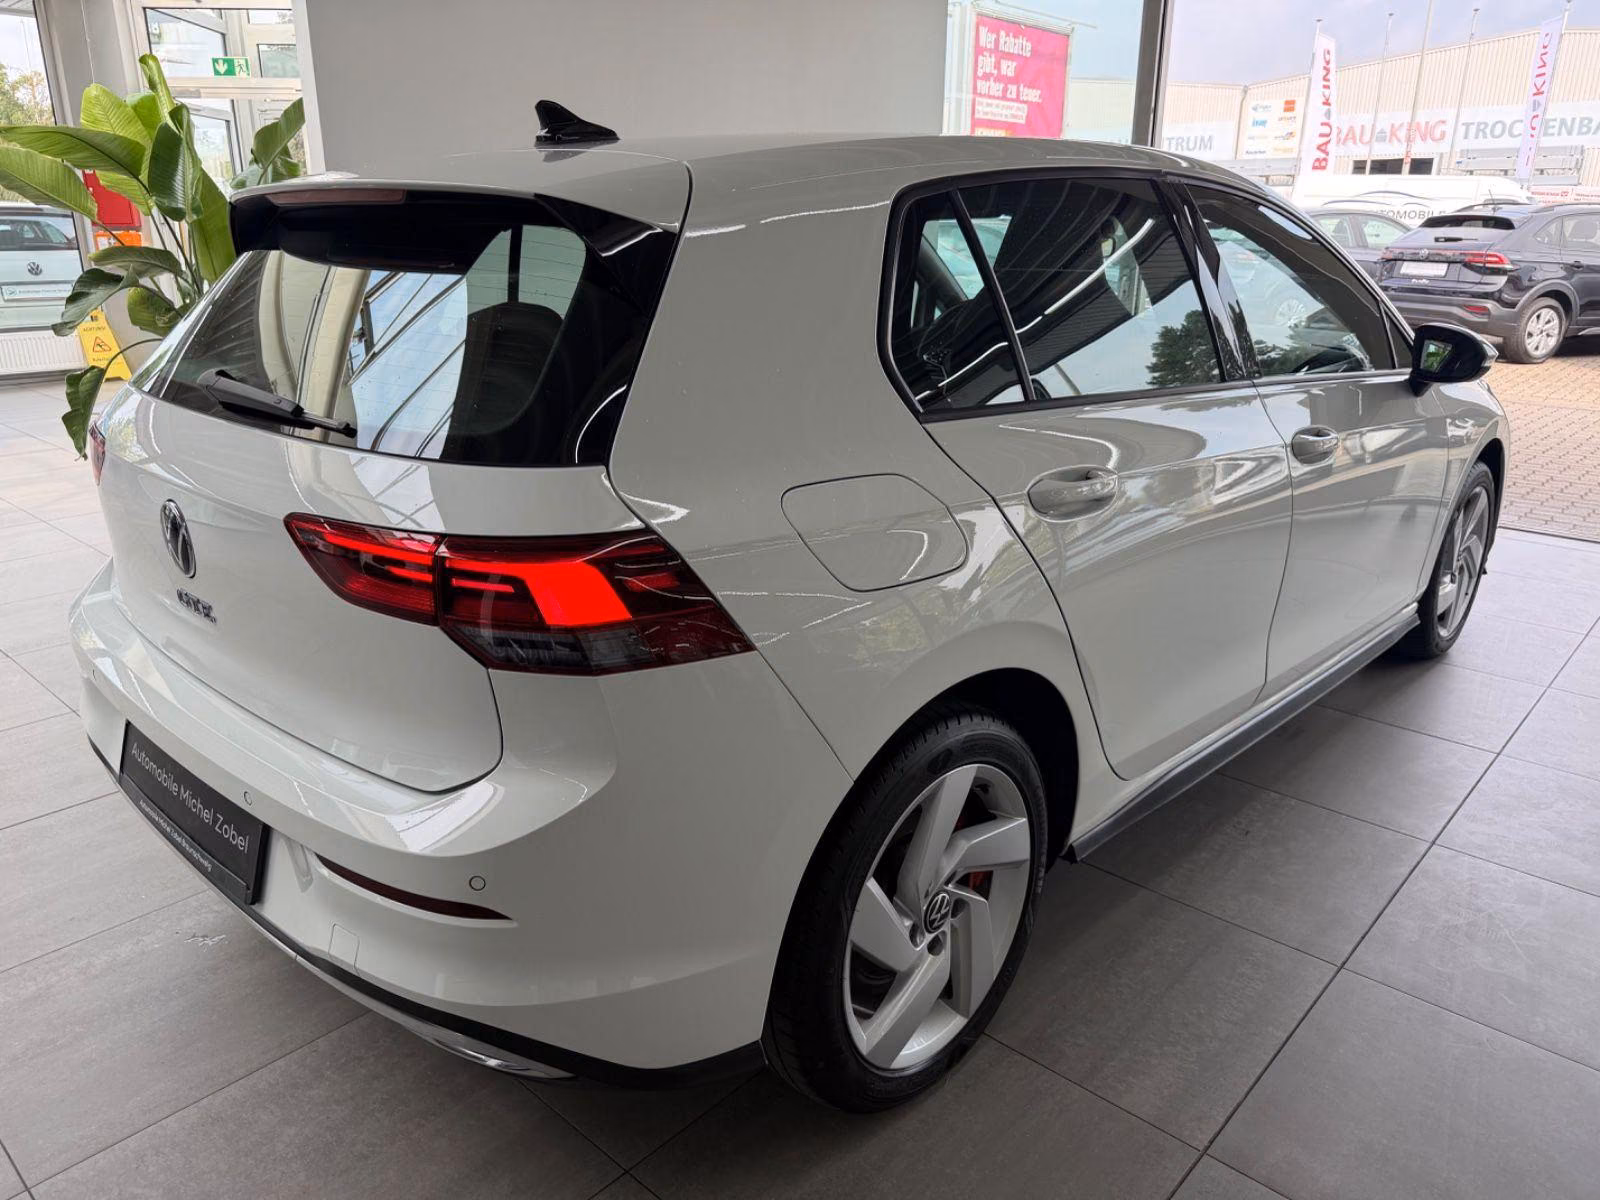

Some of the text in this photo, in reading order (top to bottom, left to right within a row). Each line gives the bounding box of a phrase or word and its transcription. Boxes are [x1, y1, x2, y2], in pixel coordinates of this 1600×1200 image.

[979, 26, 1033, 58] Wer Rabatte
[977, 51, 1017, 77] gibt, war
[976, 78, 1005, 97] vorher
[1006, 84, 1018, 98] zu
[1311, 48, 1333, 171] BAU KING
[131, 742, 250, 854] Automobile Michel Zobel
